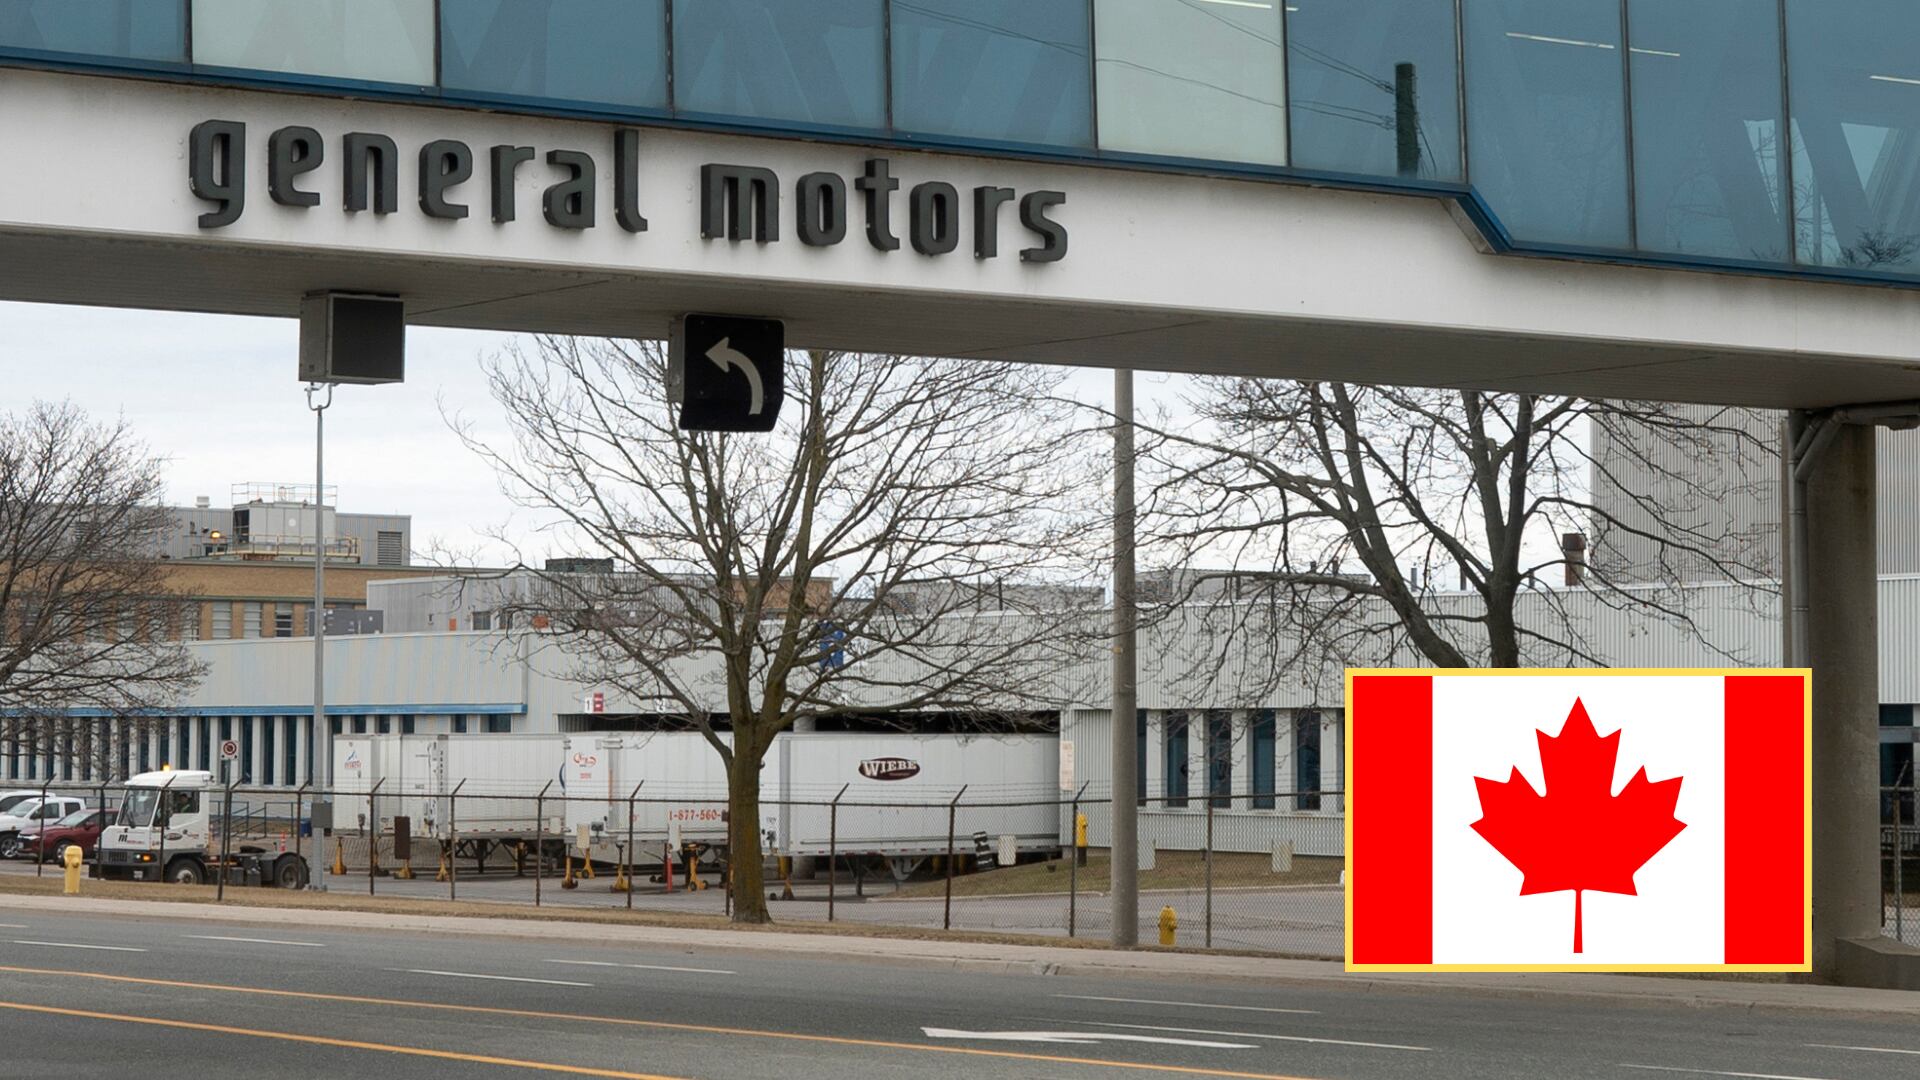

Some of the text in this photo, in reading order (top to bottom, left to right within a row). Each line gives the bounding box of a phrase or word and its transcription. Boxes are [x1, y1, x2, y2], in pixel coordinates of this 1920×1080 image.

[189, 119, 1068, 263] general motors
[861, 760, 917, 776] WIEBE
[669, 809, 721, 821] 1-877-560-
